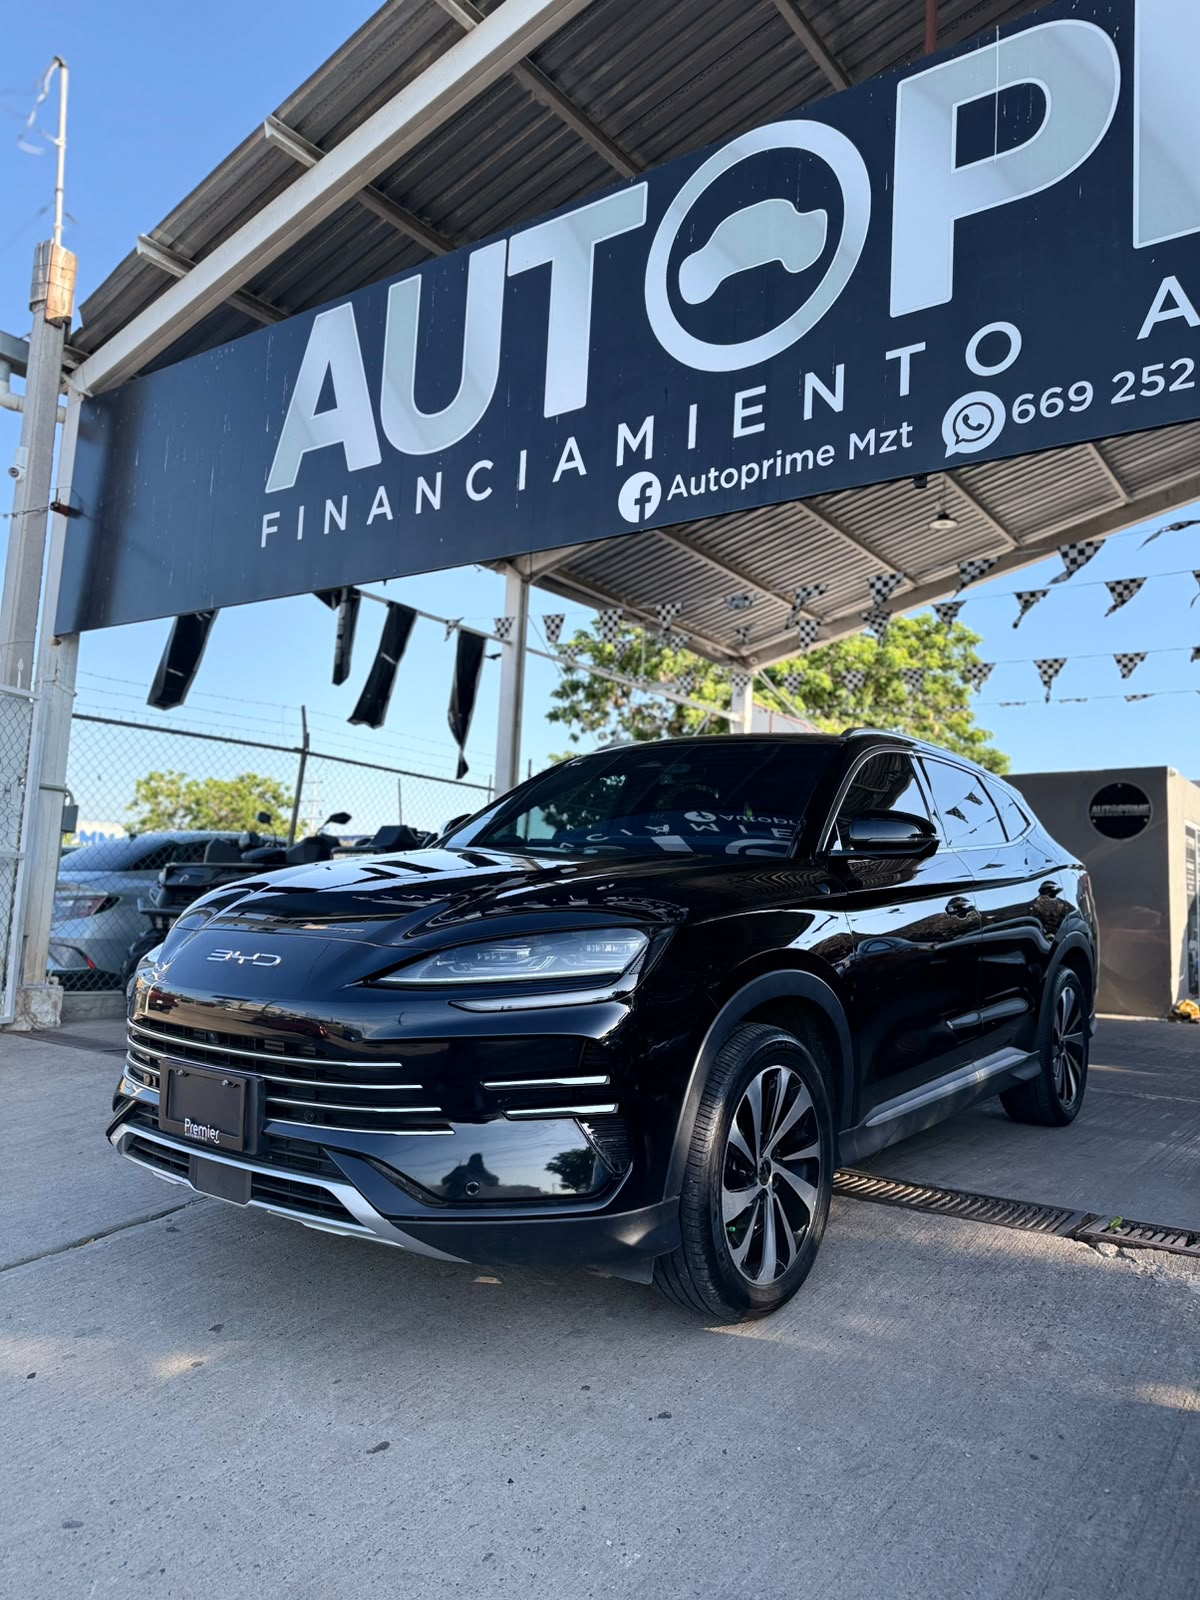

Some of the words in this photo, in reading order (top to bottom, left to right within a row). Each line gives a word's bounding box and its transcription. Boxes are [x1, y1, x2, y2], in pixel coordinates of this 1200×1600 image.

[1011, 380, 1094, 425] 669
[1111, 357, 1196, 405] 252
[261, 321, 1022, 547] FINANCIAMIENTO
[667, 443, 835, 501] Autoprime
[848, 420, 914, 461] Mzt
[206, 948, 282, 967] BYD
[184, 1117, 220, 1143] Premier
